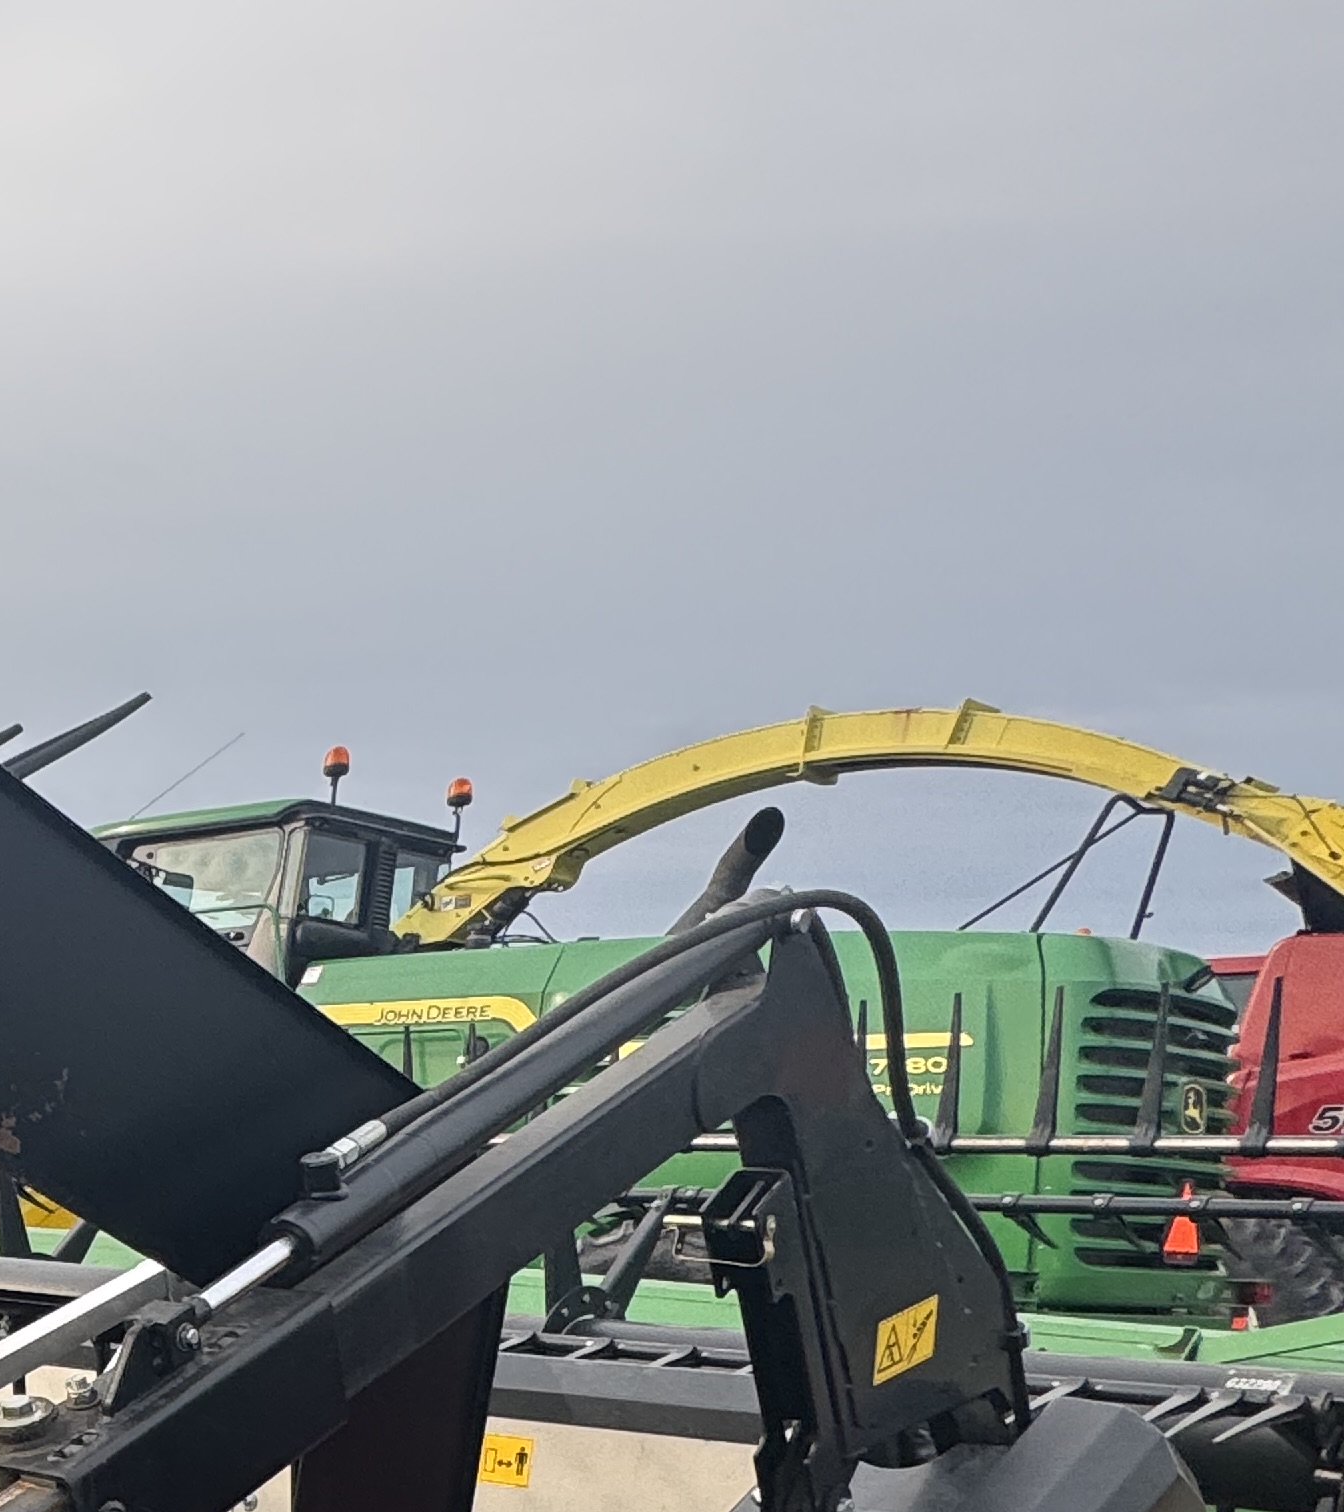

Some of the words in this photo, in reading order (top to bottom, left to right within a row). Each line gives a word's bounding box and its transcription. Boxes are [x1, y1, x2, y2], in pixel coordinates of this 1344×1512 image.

[374, 1008, 424, 1022] JOHN
[427, 1004, 492, 1020] DEERE
[869, 1056, 948, 1074] 780
